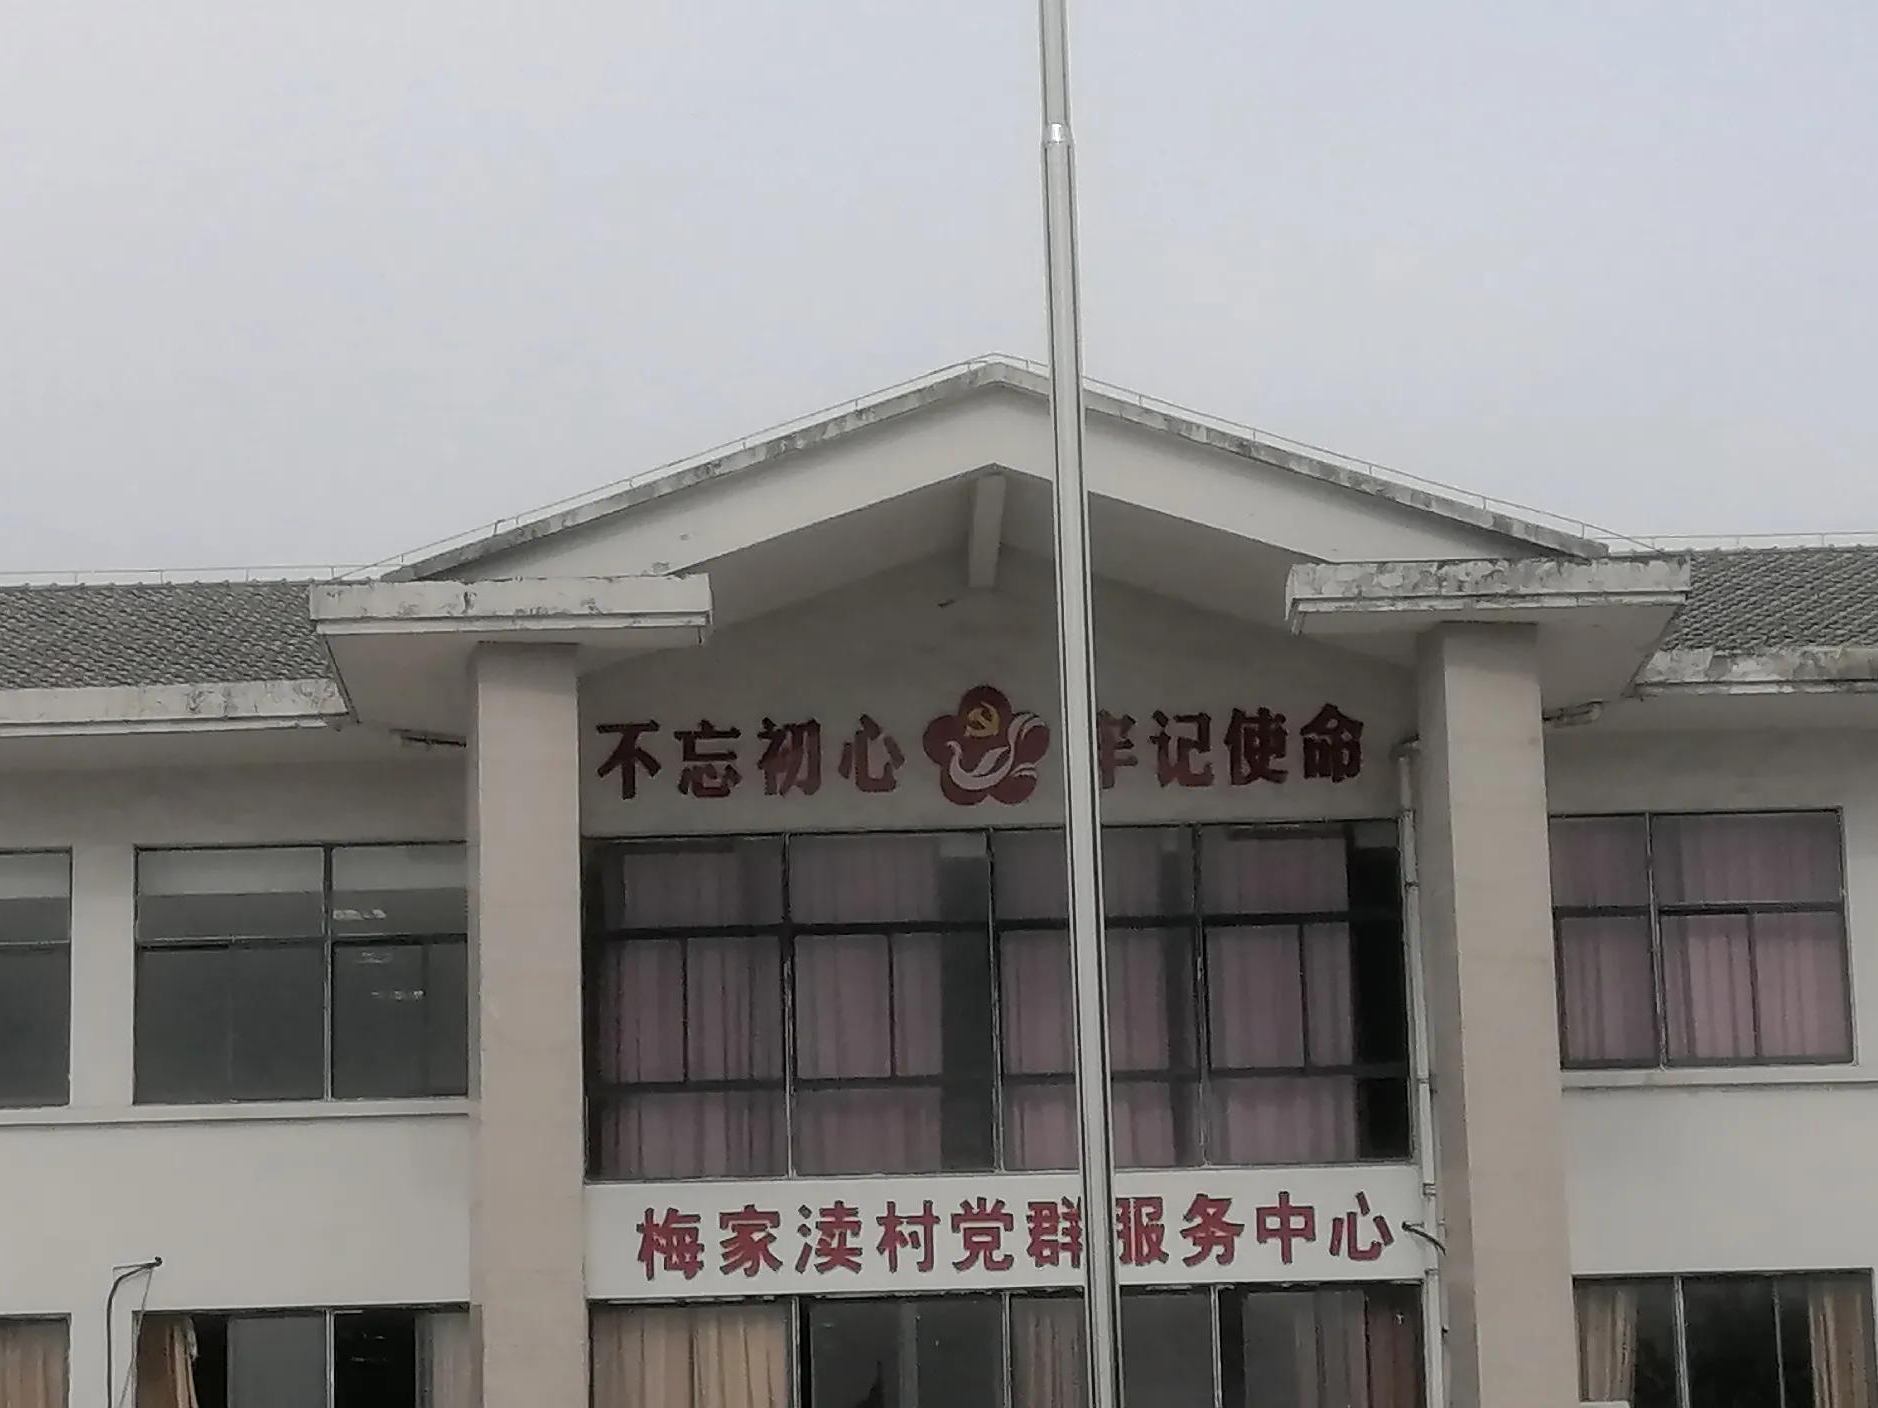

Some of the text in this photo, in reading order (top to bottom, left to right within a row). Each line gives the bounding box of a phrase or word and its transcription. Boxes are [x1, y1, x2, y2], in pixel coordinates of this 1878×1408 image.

[596, 713, 904, 799] 不忘初心
[635, 1190, 1396, 1282] 梅家渎村党群服务中心
